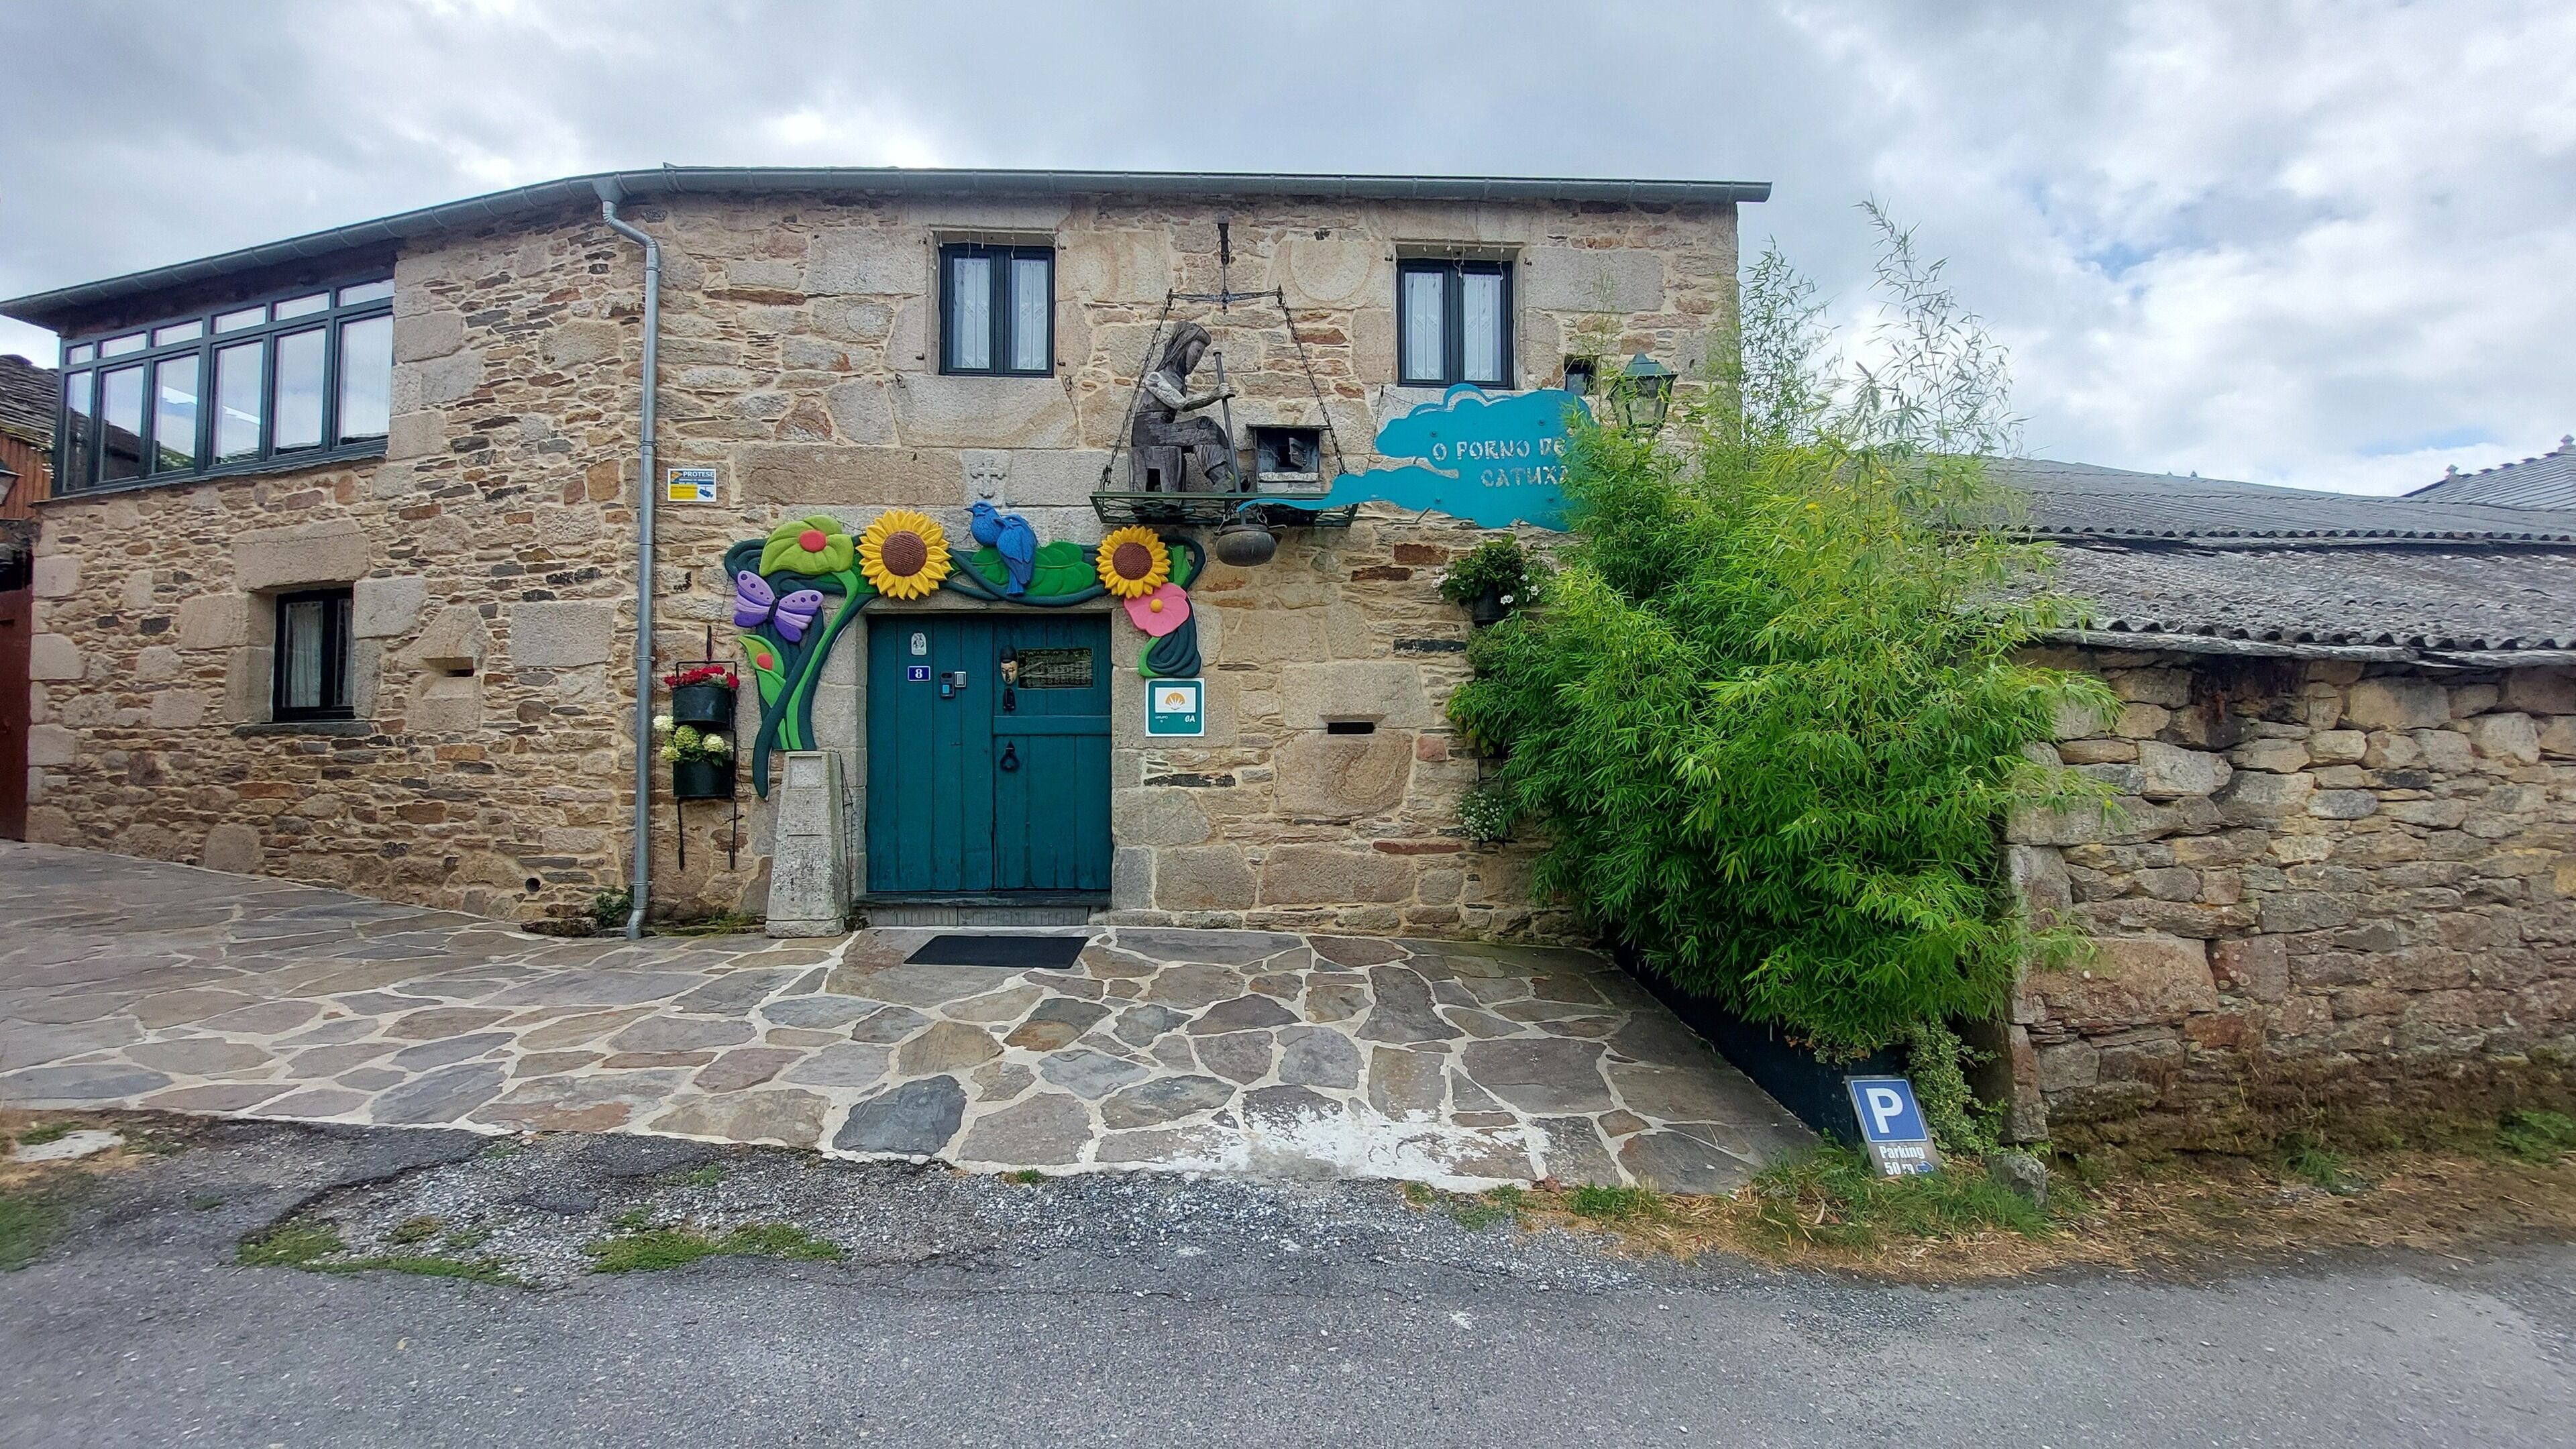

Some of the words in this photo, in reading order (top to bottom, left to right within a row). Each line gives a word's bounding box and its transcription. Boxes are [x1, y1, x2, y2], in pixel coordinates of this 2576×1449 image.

[1432, 442, 1447, 461] O
[1456, 439, 1531, 460] FORNO
[915, 668, 923, 679] 8
[1866, 1087, 1903, 1134] P
[1878, 1145, 1925, 1160] Parking
[1884, 1162, 1901, 1175] 50
